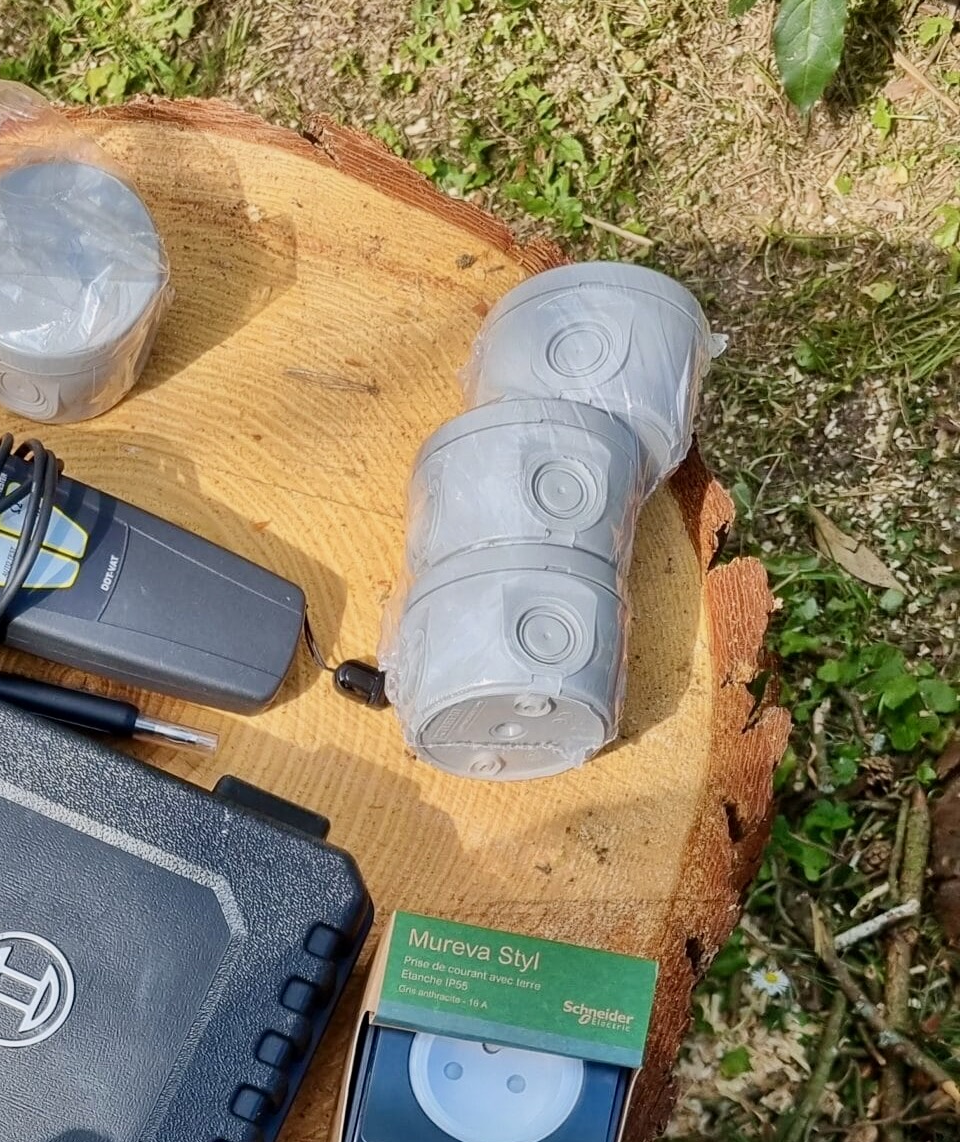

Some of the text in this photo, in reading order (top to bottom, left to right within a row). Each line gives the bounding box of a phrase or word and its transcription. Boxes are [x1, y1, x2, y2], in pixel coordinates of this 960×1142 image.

[408, 928, 540, 972] Mureva Styl
[404, 955, 541, 991] Prise de courant avec terre
[399, 984, 416, 995] Gris
[418, 987, 460, 1004] anthracite
[446, 978, 468, 991] IP55
[563, 1000, 634, 1024] Schneider
[591, 1017, 631, 1032] Electric
